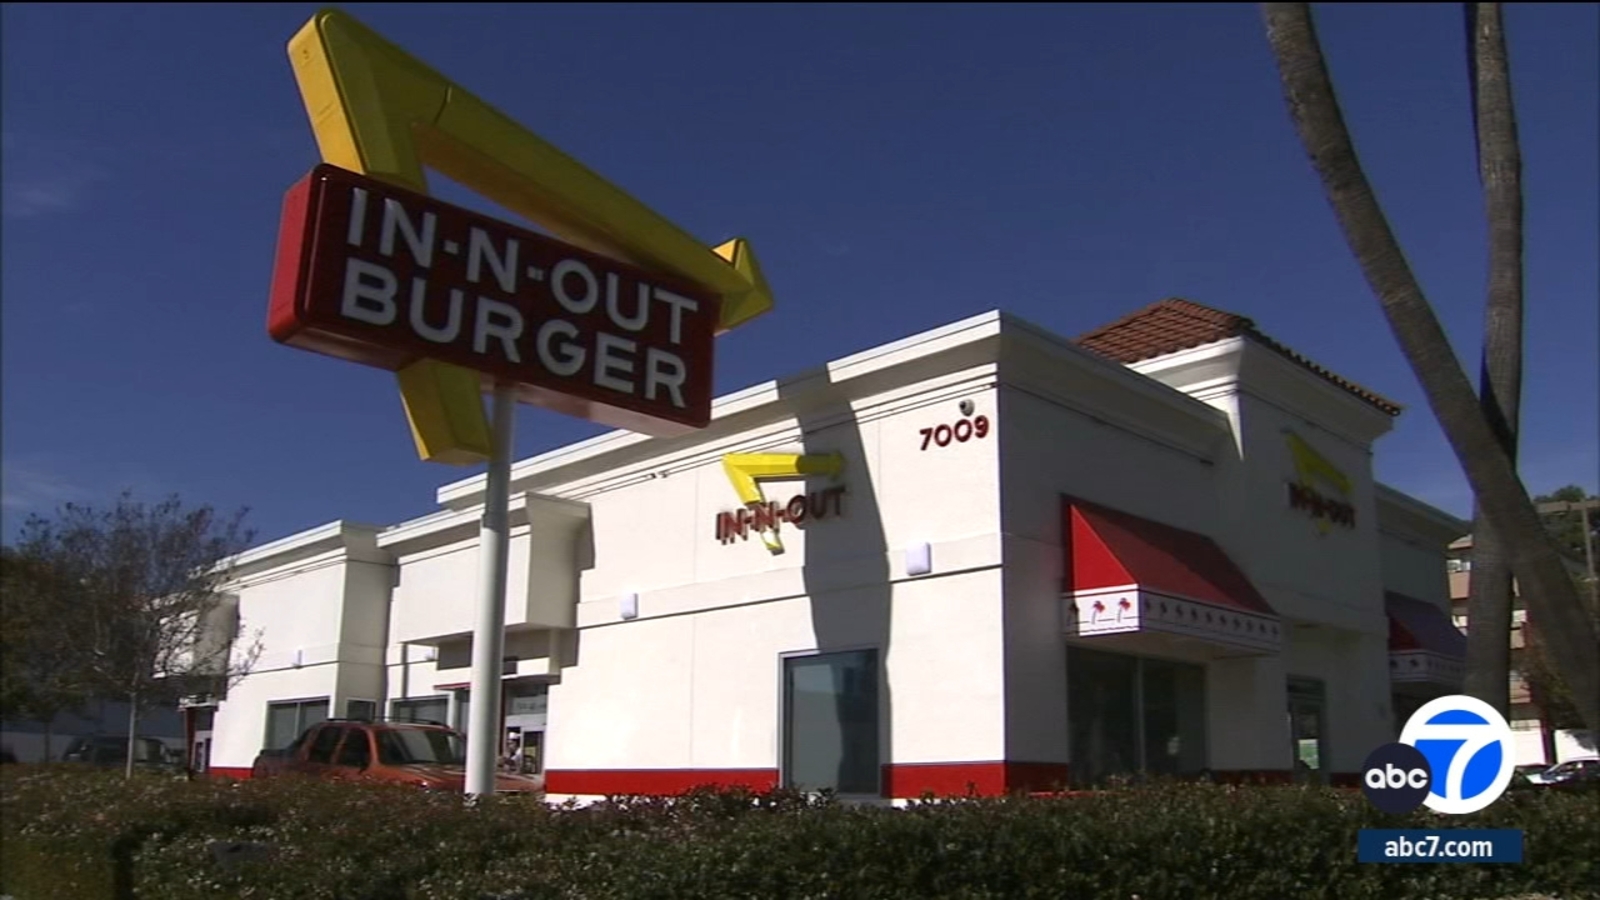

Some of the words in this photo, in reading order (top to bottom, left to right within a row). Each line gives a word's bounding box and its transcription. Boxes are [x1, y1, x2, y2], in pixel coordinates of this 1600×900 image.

[345, 187, 698, 345] IN-N-OUT
[340, 258, 687, 408] BURGER
[919, 414, 990, 451] 7009
[715, 486, 846, 544] IN-N-OUT
